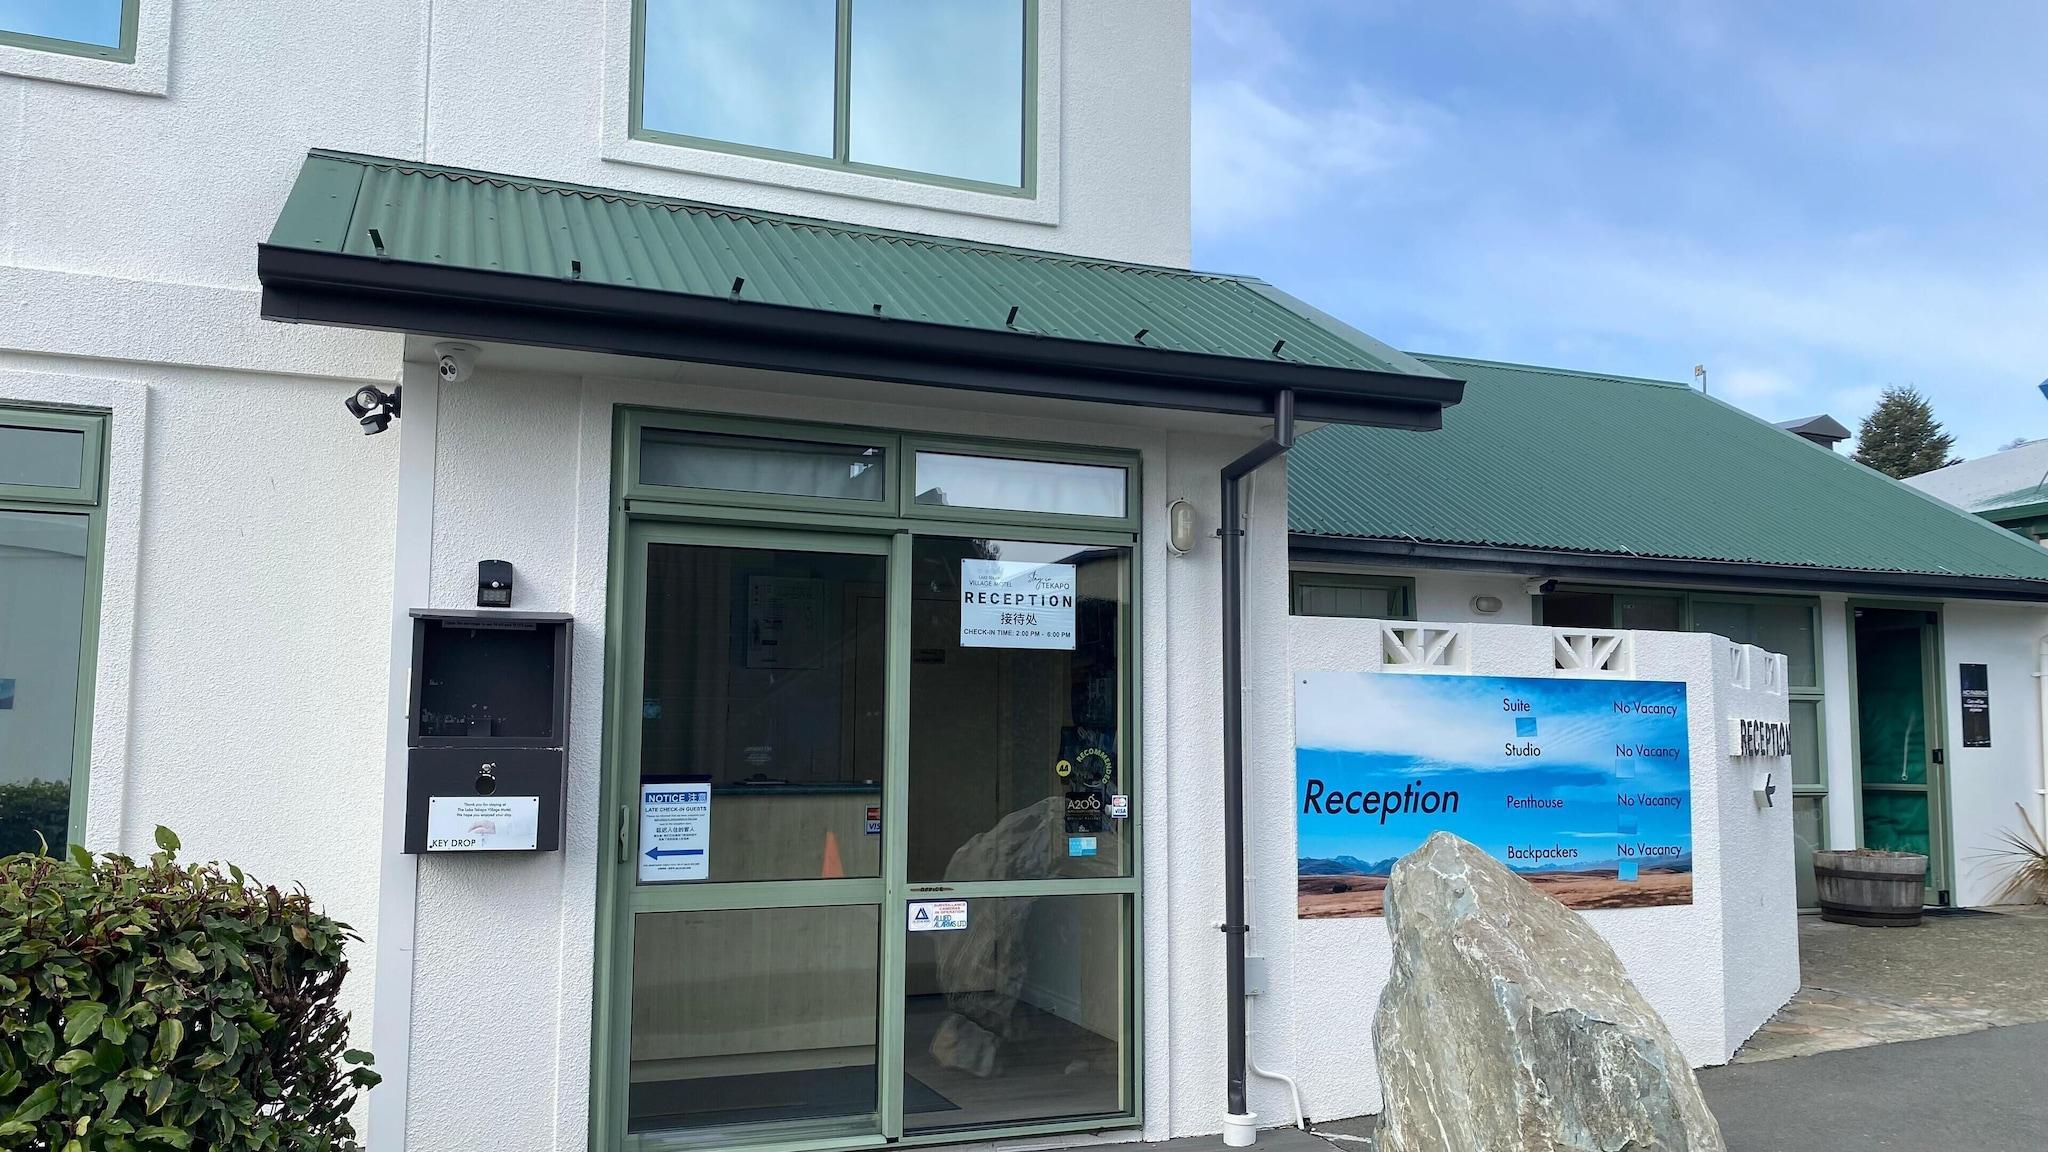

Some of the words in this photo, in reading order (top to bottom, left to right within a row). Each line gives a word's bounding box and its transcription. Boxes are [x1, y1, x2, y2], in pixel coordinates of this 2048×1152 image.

[969, 579, 992, 587] VILLAGE
[1042, 581, 1070, 590] TEKAPO
[964, 591, 1072, 607] RECEPTION
[1000, 612, 1037, 626] 接待处
[1503, 698, 1530, 712] Suite
[1613, 700, 1631, 714] No
[1633, 700, 1678, 718] Vacancy
[1740, 719, 1791, 757] RECEPTION
[1505, 742, 1541, 757] Studio
[1616, 744, 1633, 757] No
[1636, 744, 1680, 760] Vacancy
[1076, 748, 1112, 784] RECOMMENDED
[648, 793, 685, 803] NOTICE
[1303, 779, 1459, 825] Reception
[1507, 794, 1563, 808] Penthouse
[1617, 793, 1635, 807] No
[1637, 793, 1682, 809] Vacancy
[869, 823, 881, 831] VIS
[432, 839, 449, 848] KEY
[451, 839, 476, 847] DROP
[1617, 843, 1635, 857] No
[1637, 843, 1682, 859] Vacancy
[1508, 844, 1578, 862] Backpackers
